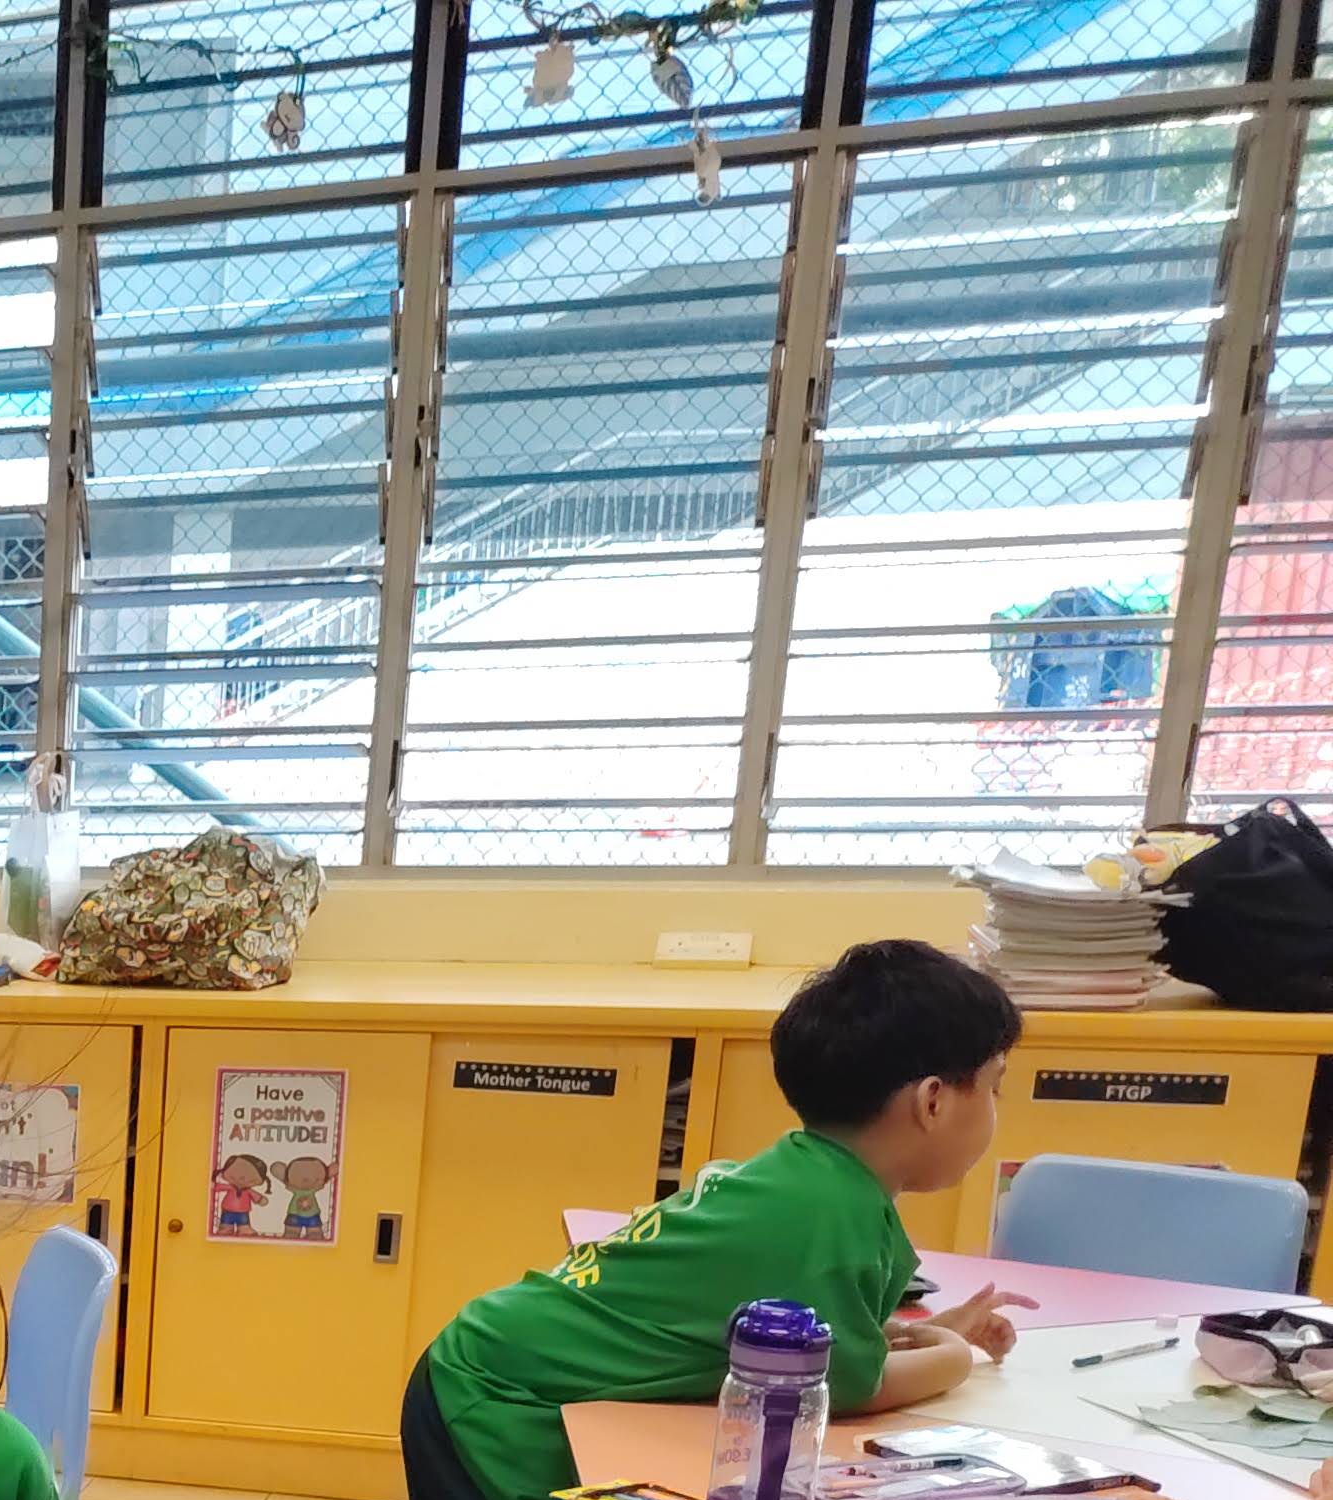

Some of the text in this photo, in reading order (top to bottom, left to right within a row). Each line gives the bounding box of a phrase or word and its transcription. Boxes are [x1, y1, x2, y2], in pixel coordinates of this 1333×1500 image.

[474, 1071, 591, 1093] Mother Tongue
[256, 1085, 304, 1101] Have
[1105, 1083, 1153, 1101] FTGP
[233, 1105, 326, 1123] a positive
